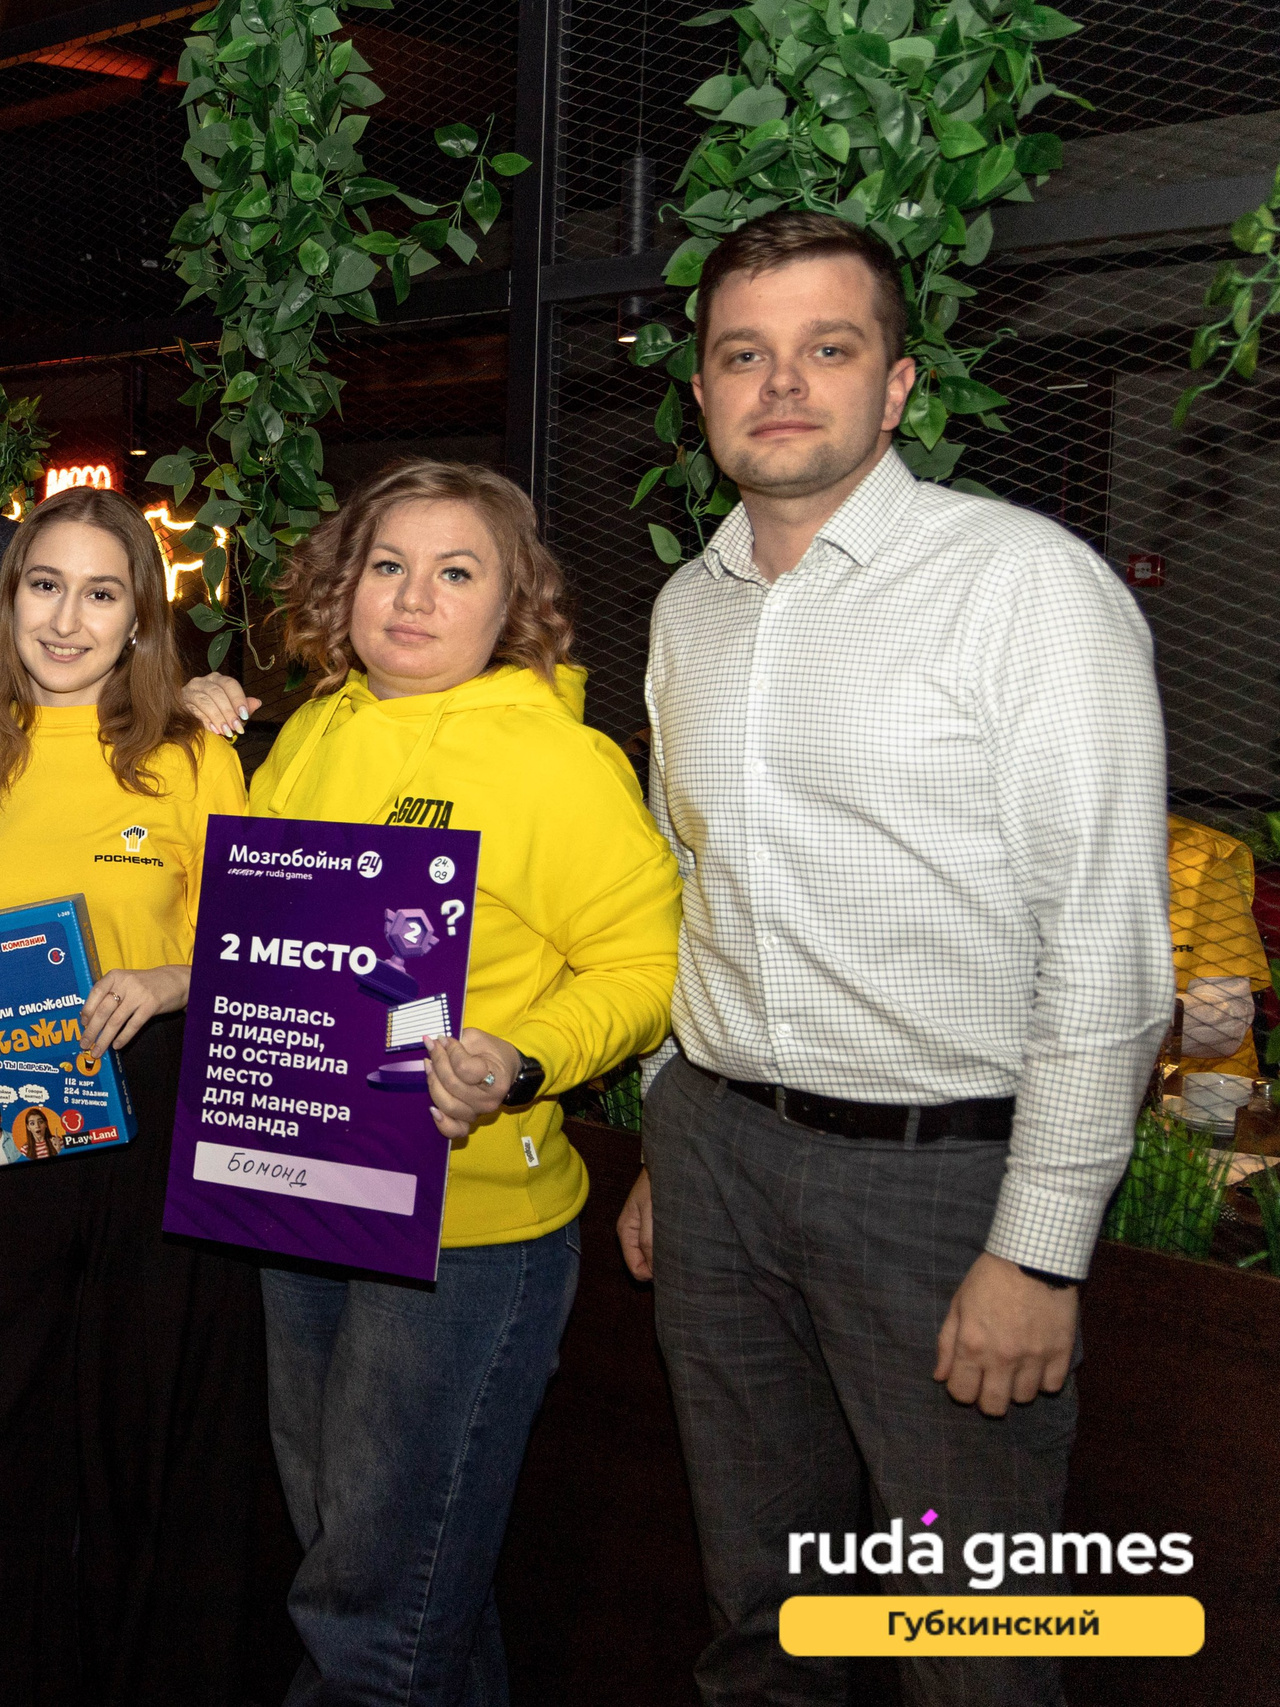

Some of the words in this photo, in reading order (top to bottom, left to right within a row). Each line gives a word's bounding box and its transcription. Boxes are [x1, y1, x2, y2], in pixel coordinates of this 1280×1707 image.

[94, 854, 164, 867] РОСНЕФТЬ
[228, 844, 353, 871] Мозгобойня
[285, 871, 313, 880] games
[434, 870, 448, 881] 09
[441, 899, 465, 936] ?
[403, 922, 422, 944] 2
[219, 932, 241, 962] 2
[249, 935, 378, 976] МЕСТО
[213, 995, 336, 1028] Ворвалась
[210, 1021, 224, 1036] в
[228, 1023, 326, 1053] лидеры,
[208, 1043, 236, 1060] но
[242, 1048, 349, 1075] оставила
[65, 1077, 76, 1085] 112
[206, 1065, 273, 1088] место
[63, 1096, 69, 1104] 6
[64, 1087, 80, 1095] 224
[202, 1087, 245, 1107] для
[250, 1092, 351, 1123] маневра
[201, 1108, 300, 1138] команда
